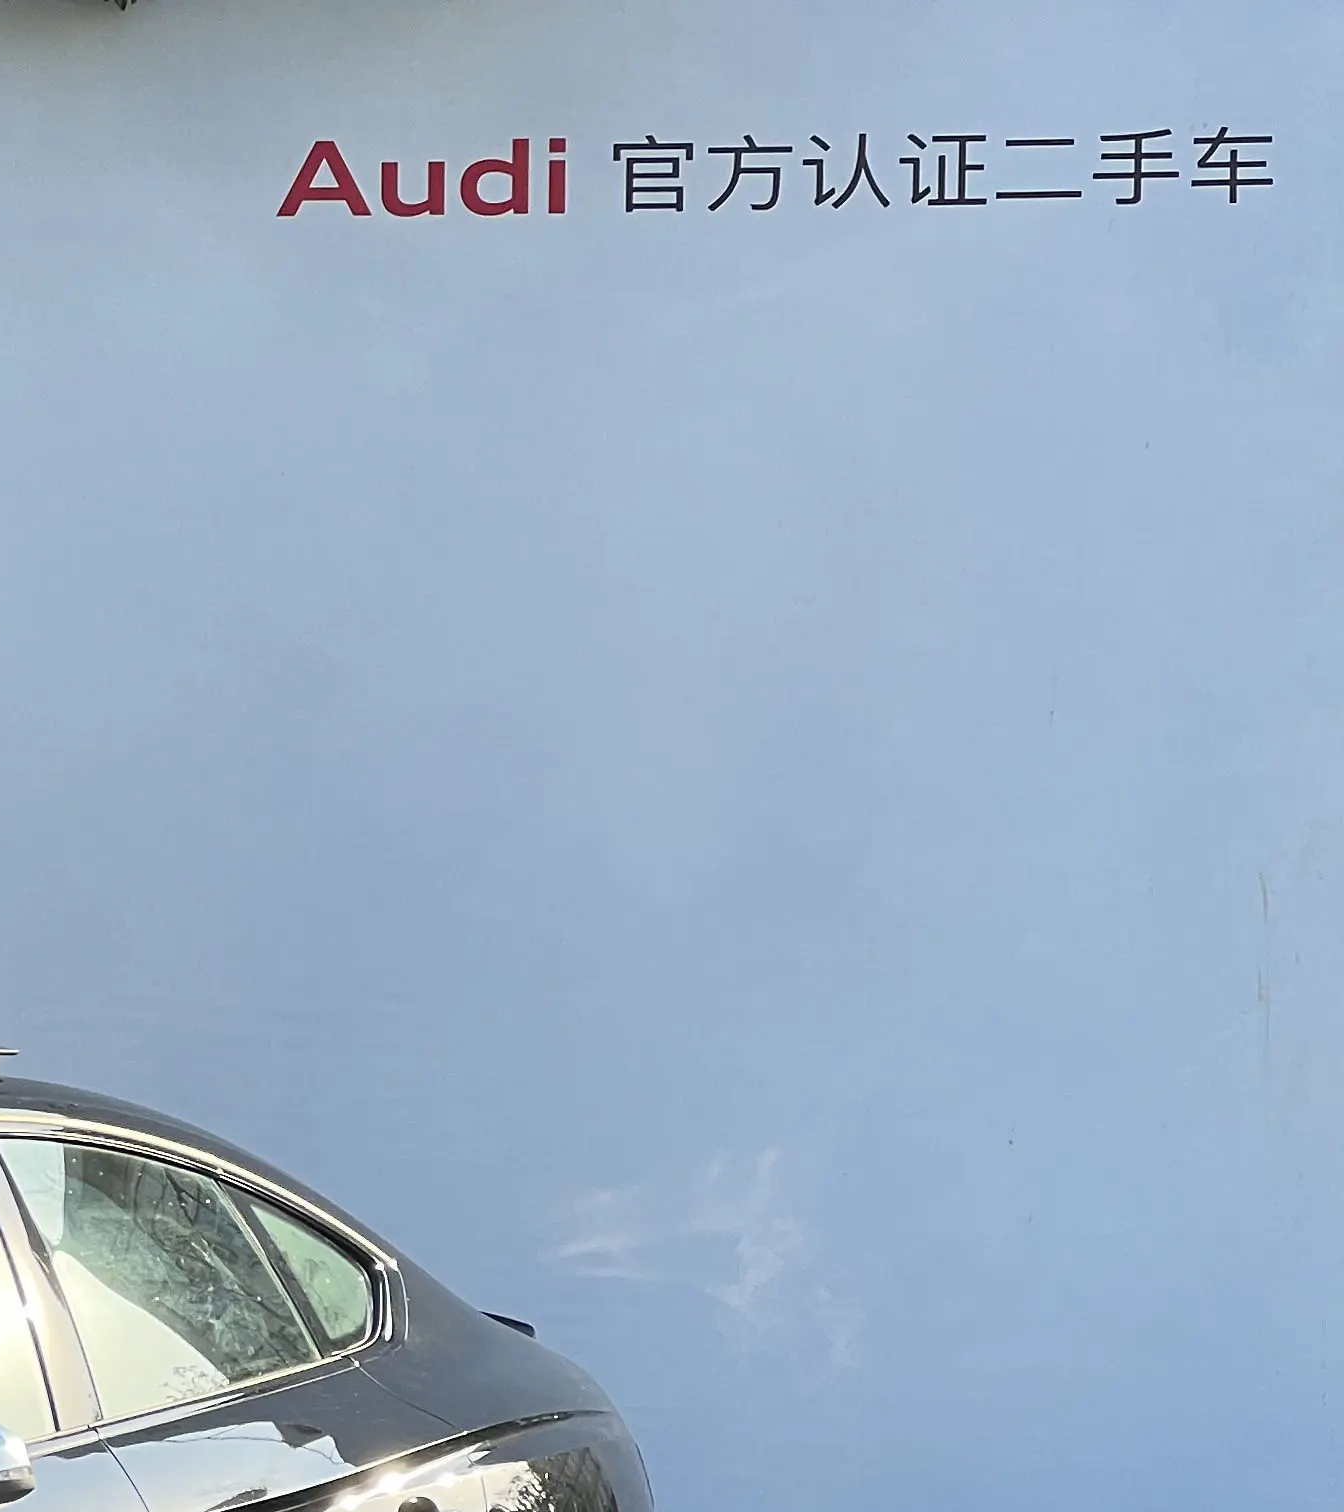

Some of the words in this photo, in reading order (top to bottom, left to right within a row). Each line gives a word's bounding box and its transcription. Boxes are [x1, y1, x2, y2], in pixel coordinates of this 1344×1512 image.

[276, 137, 567, 217] Audi
[611, 125, 1275, 213] 官方认证二手车
